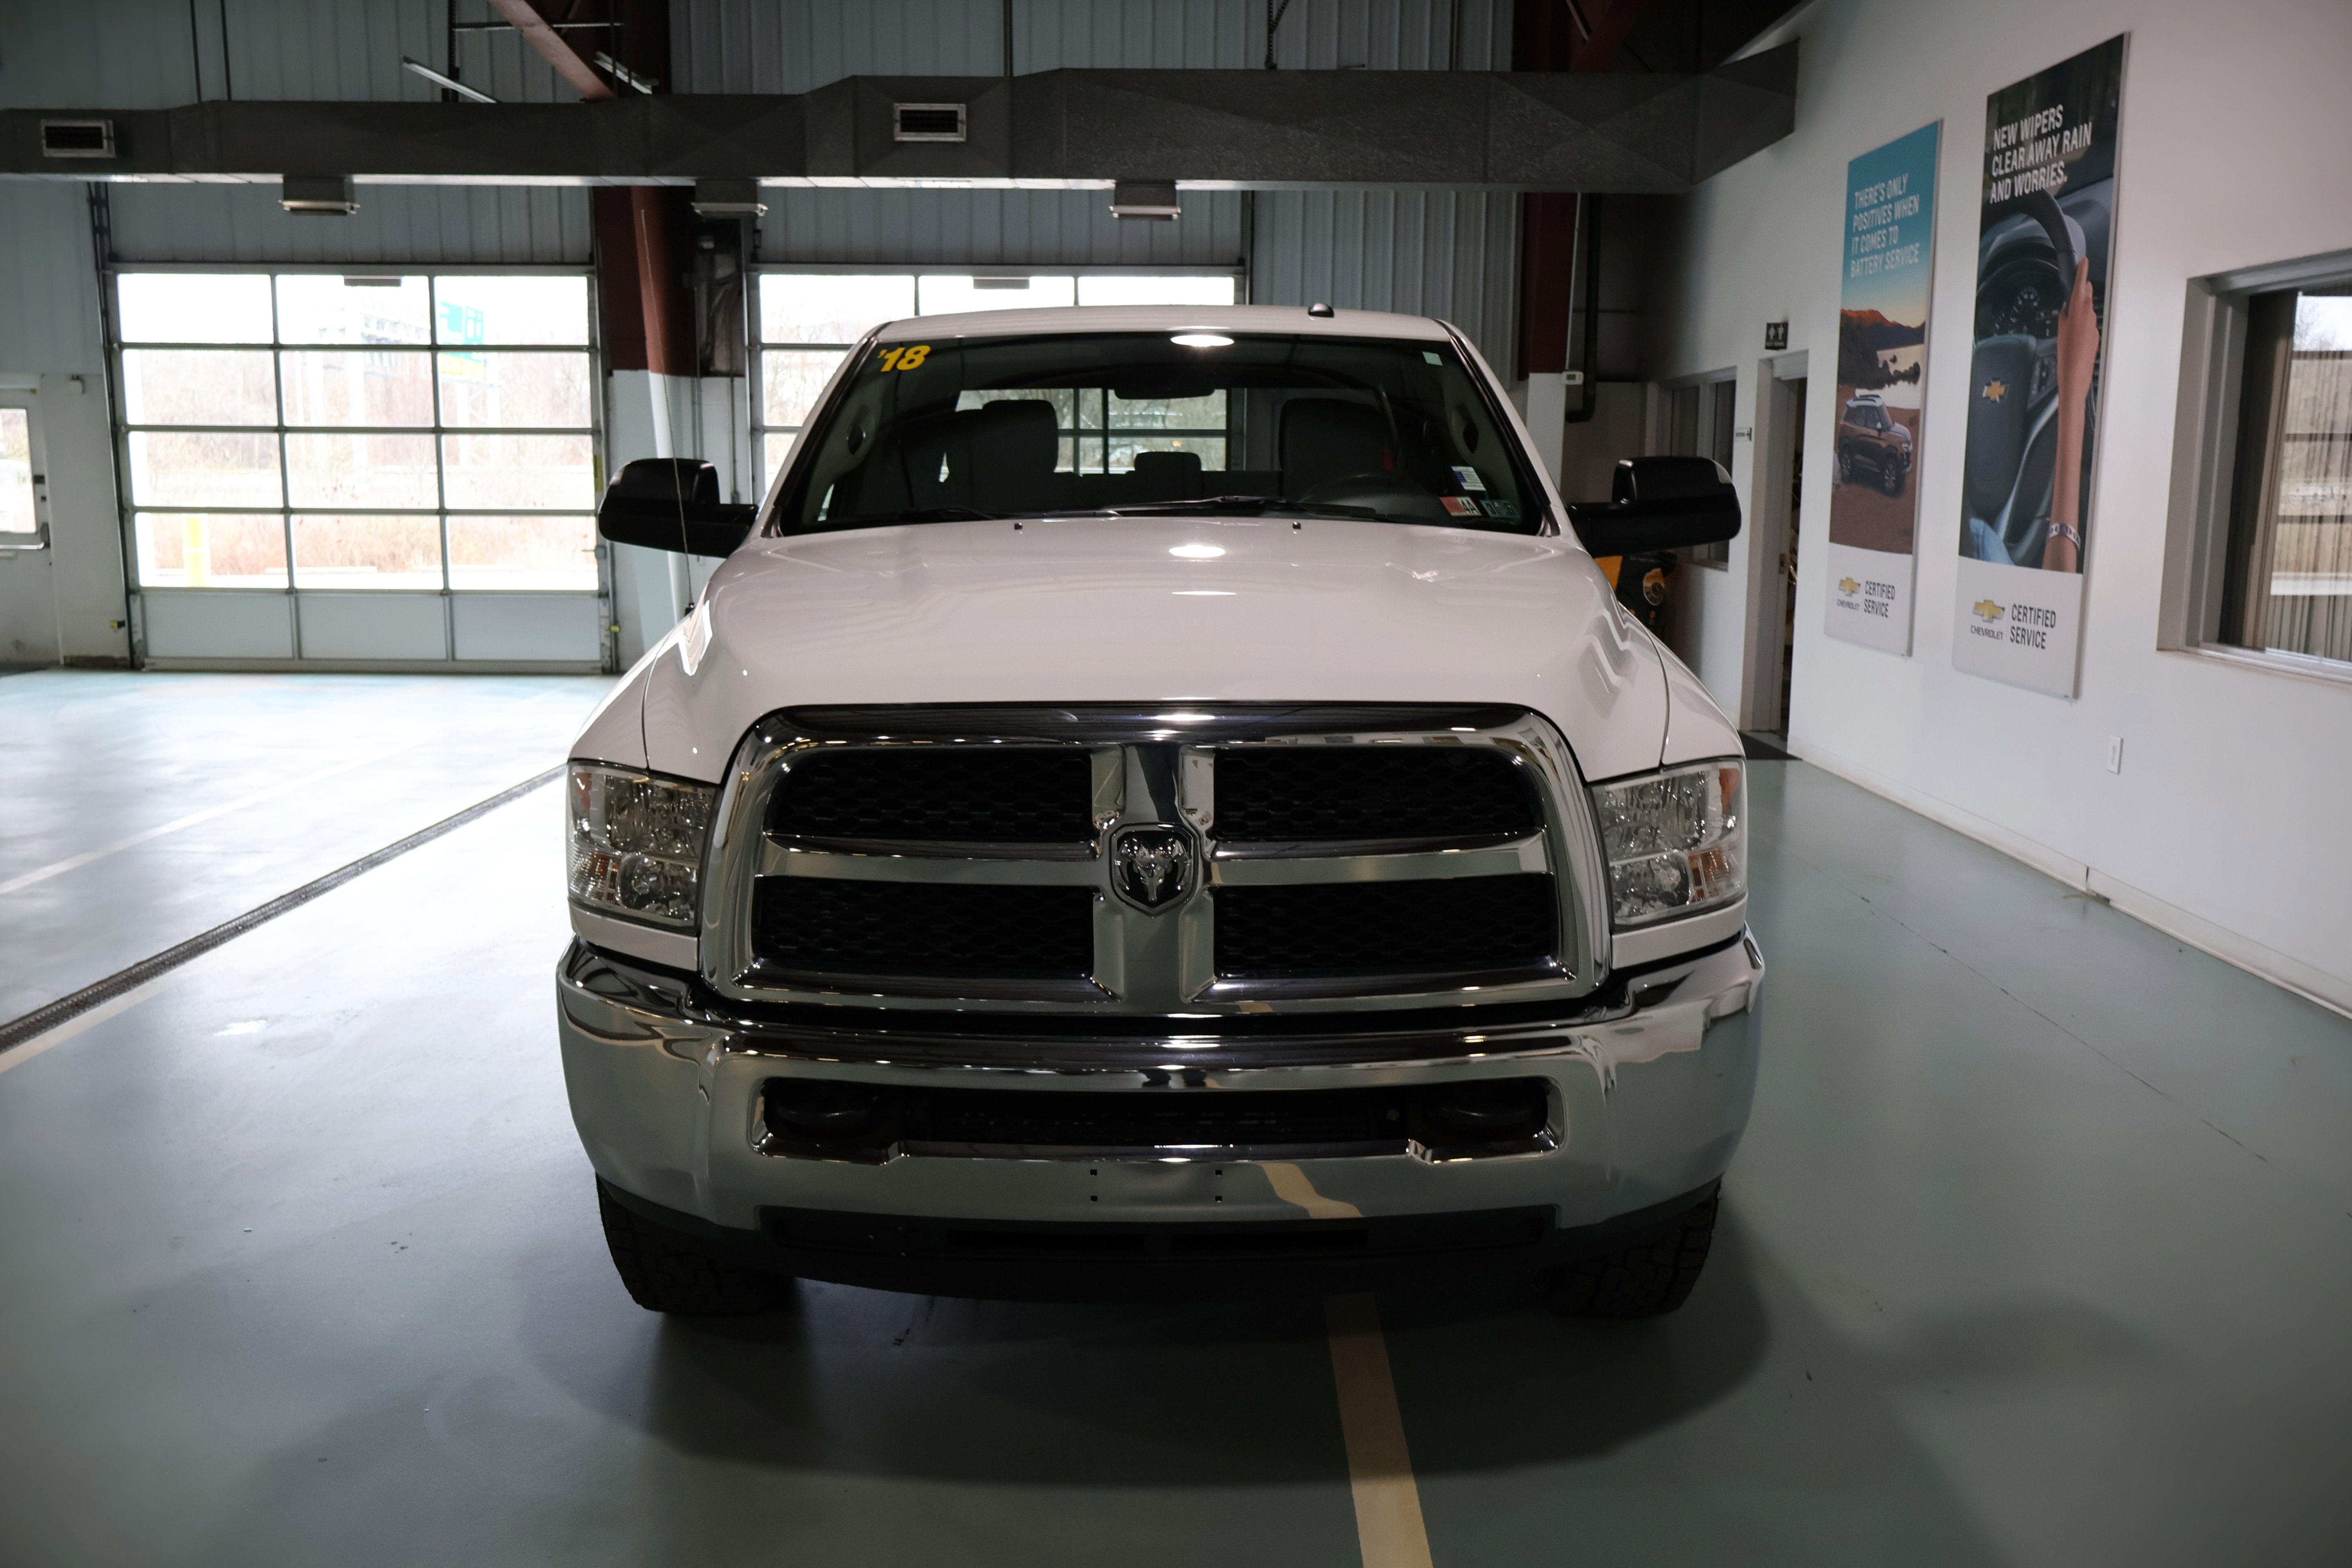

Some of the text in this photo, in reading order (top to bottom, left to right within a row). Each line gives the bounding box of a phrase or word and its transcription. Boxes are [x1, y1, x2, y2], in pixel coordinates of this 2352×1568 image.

[1993, 104, 2064, 151] NEW WIPERS
[1991, 121, 2092, 177] CLEAR AWAY RAIN
[1855, 173, 1909, 210] THERE'S ONLY
[1989, 160, 2068, 204] AND WORRIES.
[1853, 194, 1919, 232] POSITIVES WHEN
[1852, 225, 1898, 255] IT COMES TO
[1851, 243, 1920, 278] BATTERY SERVICE
[877, 345, 931, 372] '18
[1864, 580, 1895, 600] CERTIFIED
[1837, 599, 1860, 611] CHEVROLET
[1864, 598, 1889, 618] SERVICE
[2011, 603, 2056, 628] CERTIFIED
[1971, 625, 2004, 640] CHEVROLET
[2010, 625, 2047, 650] SERVICE
